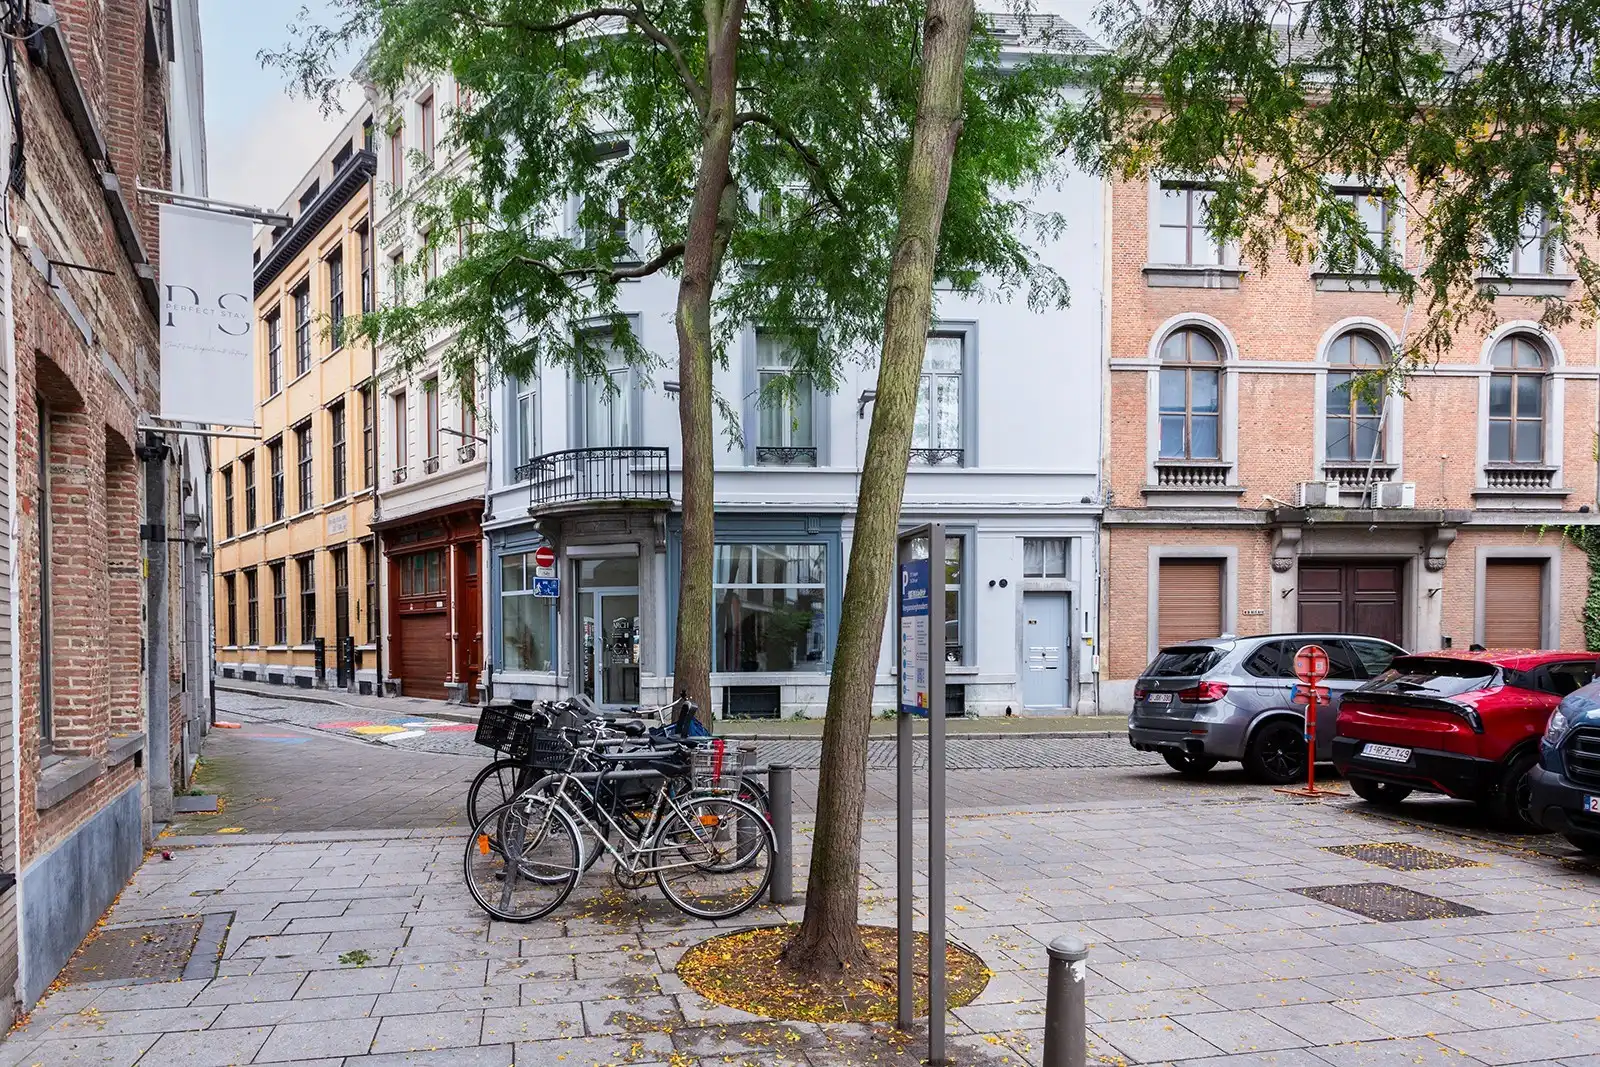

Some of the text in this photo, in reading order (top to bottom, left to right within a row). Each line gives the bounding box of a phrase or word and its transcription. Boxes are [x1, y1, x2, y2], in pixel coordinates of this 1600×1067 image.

[165, 303, 246, 319] PERFECT STAY
[902, 570, 909, 595] P
[1367, 744, 1410, 759] 1-RFZ-149
